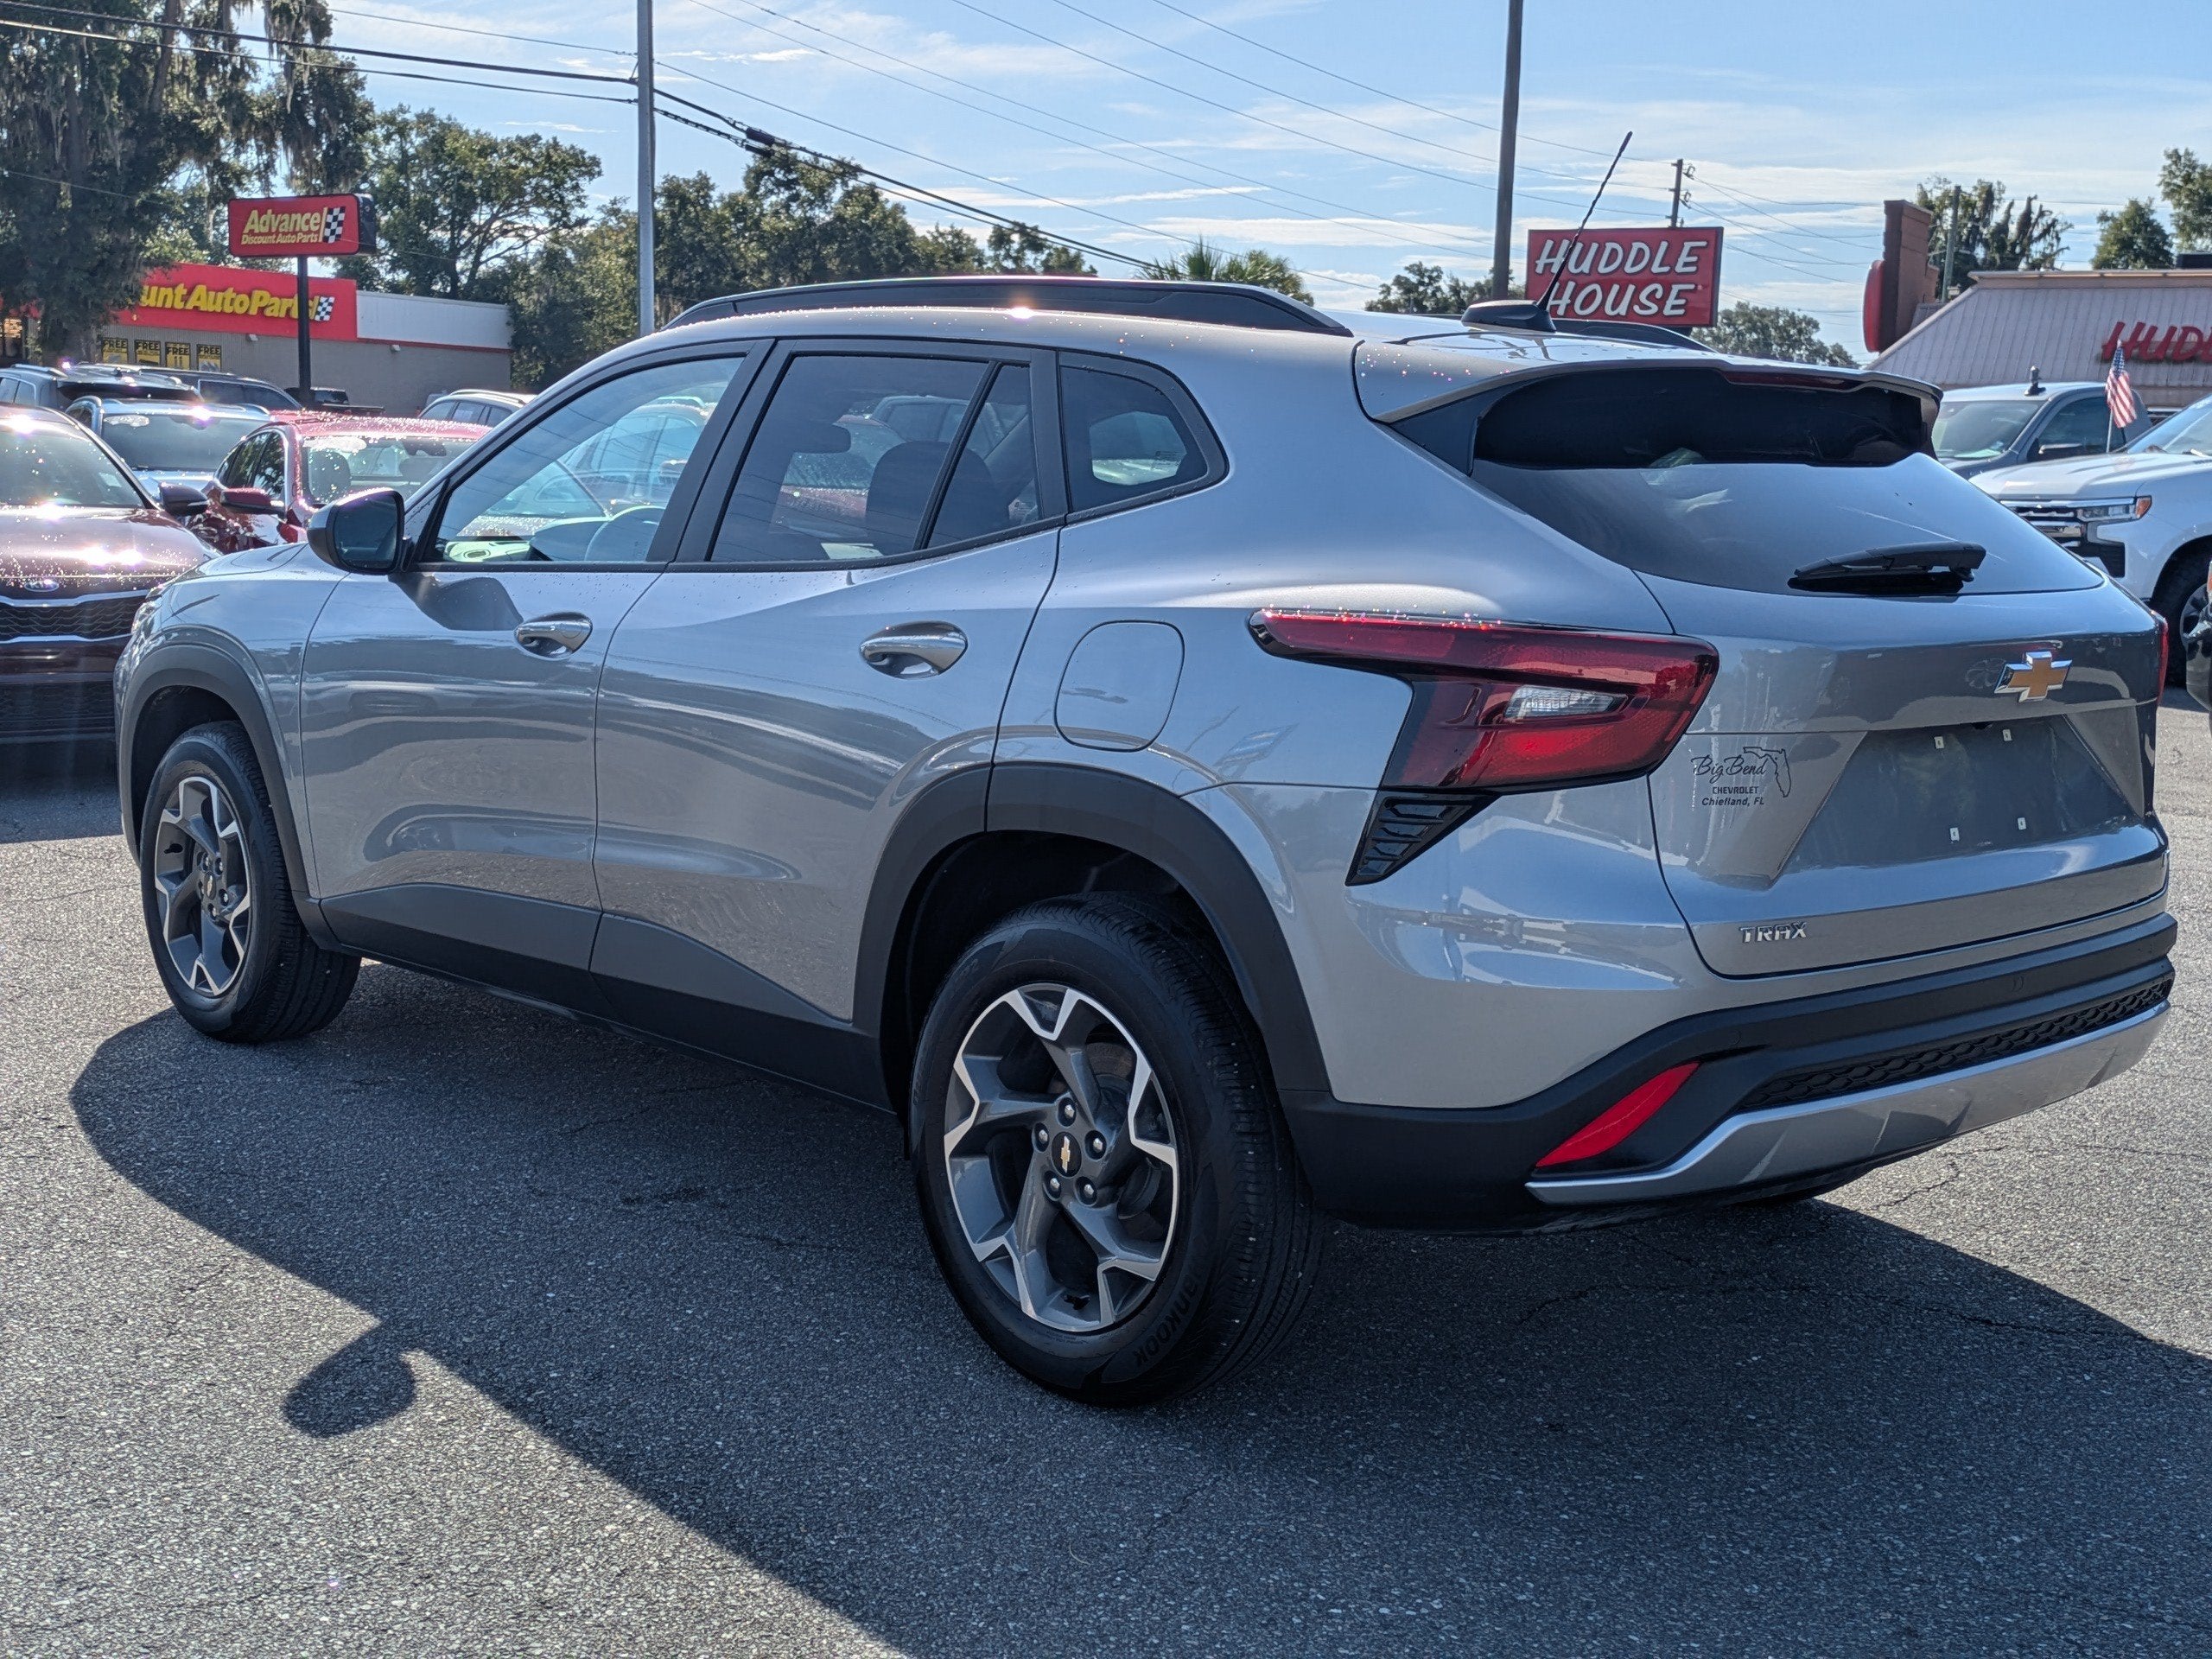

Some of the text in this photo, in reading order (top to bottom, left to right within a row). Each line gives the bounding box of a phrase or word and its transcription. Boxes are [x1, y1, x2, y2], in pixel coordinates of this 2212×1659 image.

[243, 209, 321, 233] Advance
[241, 232, 318, 245] Discount Auto Parts
[1535, 239, 1707, 274] HUDDLE
[248, 289, 314, 320] Part
[1548, 281, 1695, 316] HOUSE
[165, 346, 189, 355] FREE
[197, 345, 220, 354] FREE
[1691, 754, 1766, 784] Big Bend
[1701, 797, 1750, 807] Chiefland,
[1738, 921, 1807, 943] TRAX
